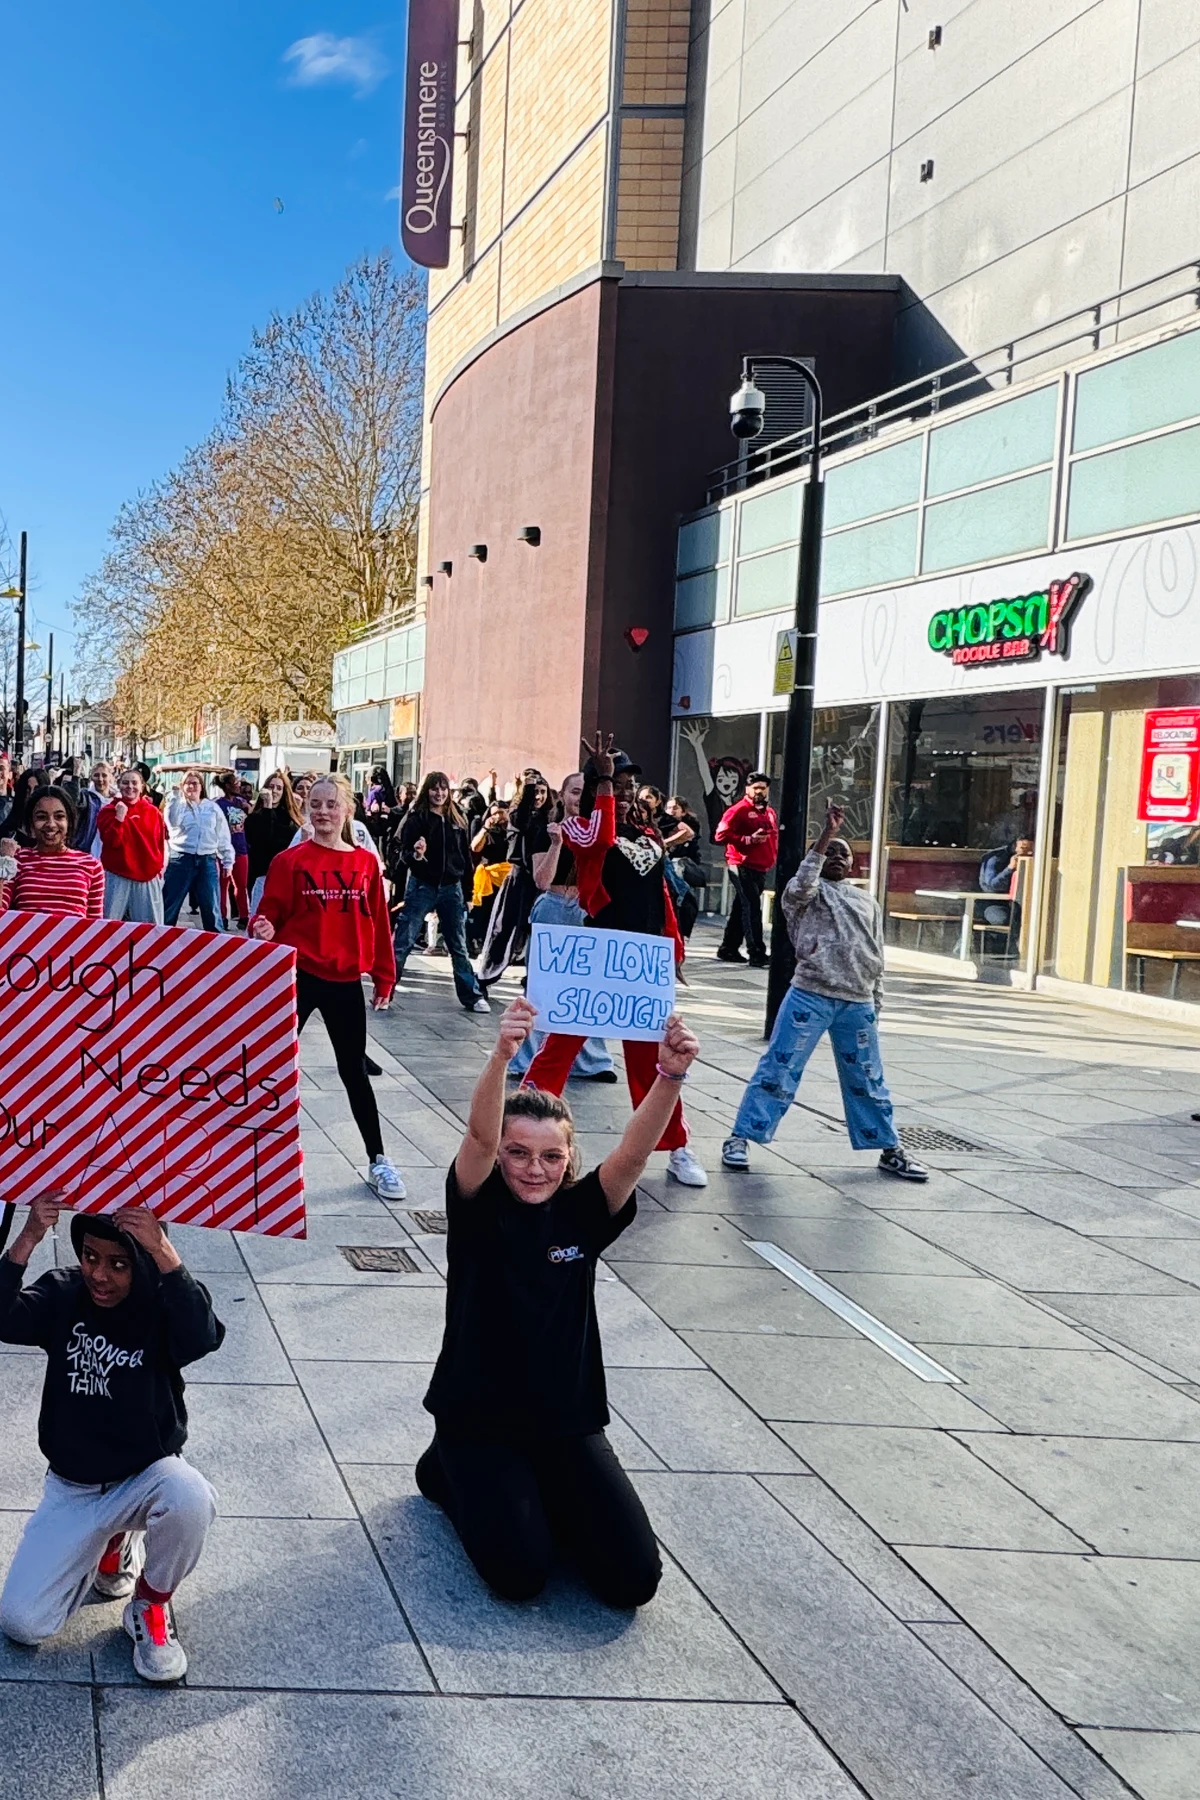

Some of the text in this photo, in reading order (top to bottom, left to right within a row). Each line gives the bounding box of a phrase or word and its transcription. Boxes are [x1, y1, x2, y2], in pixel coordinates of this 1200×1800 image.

[405, 60, 448, 234] Queensmere
[953, 639, 1031, 665] NOODLE BAR
[537, 932, 671, 986] WE LOVE
[549, 987, 673, 1030] SLOUGH
[79, 1043, 281, 1112] Needs
[72, 1110, 285, 1226] ART
[67, 1322, 144, 1368] STRONGER
[67, 1350, 115, 1377] THAN
[67, 1372, 113, 1400] THINK
